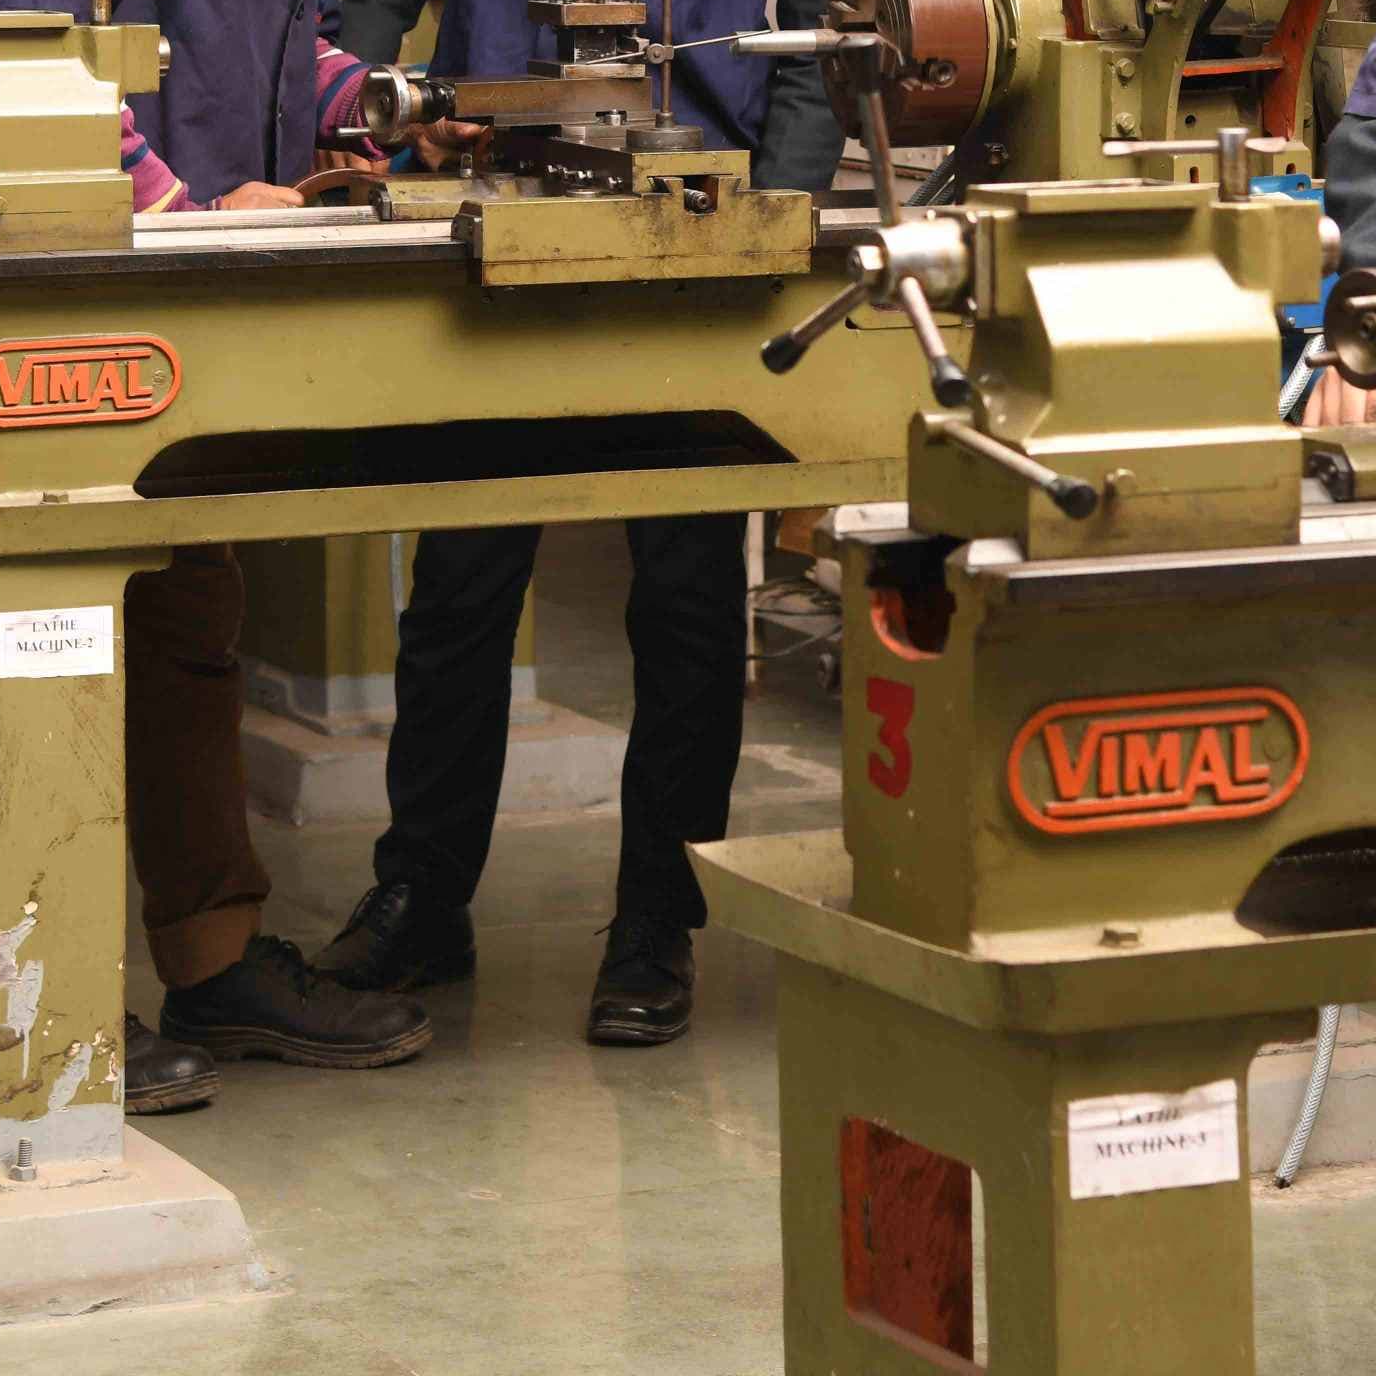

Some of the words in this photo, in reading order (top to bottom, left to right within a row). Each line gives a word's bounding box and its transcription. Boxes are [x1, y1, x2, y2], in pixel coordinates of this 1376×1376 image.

[16, 636, 94, 653] MACHINE-2
[32, 619, 79, 633] LATHE
[866, 675, 915, 800] 3
[1044, 705, 1272, 819] VIMAL
